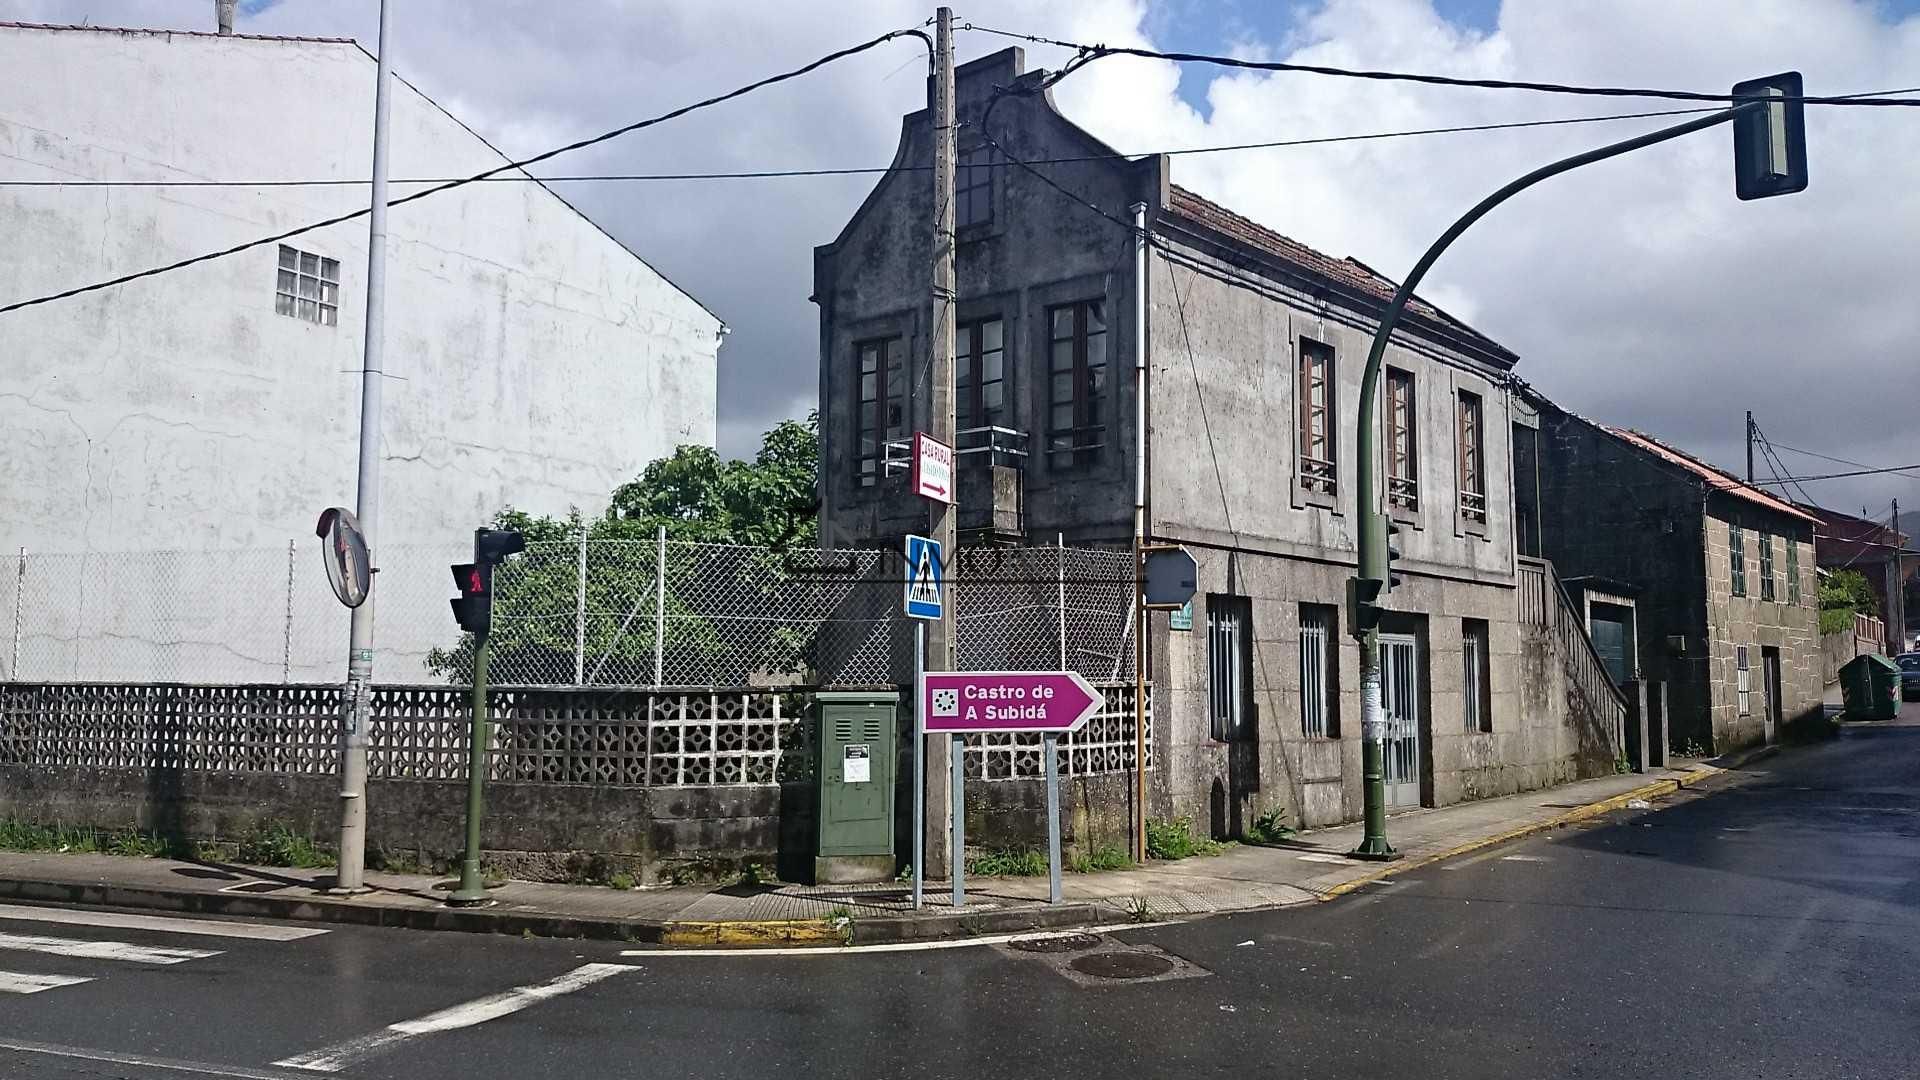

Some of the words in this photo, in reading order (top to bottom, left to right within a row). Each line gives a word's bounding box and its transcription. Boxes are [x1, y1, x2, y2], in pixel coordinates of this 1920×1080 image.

[921, 441, 934, 458] CASA
[934, 446, 949, 466] RURAL
[964, 685, 1025, 699] Castro
[1031, 685, 1054, 699] de
[965, 705, 978, 720] A
[985, 703, 1047, 720] Subidá
